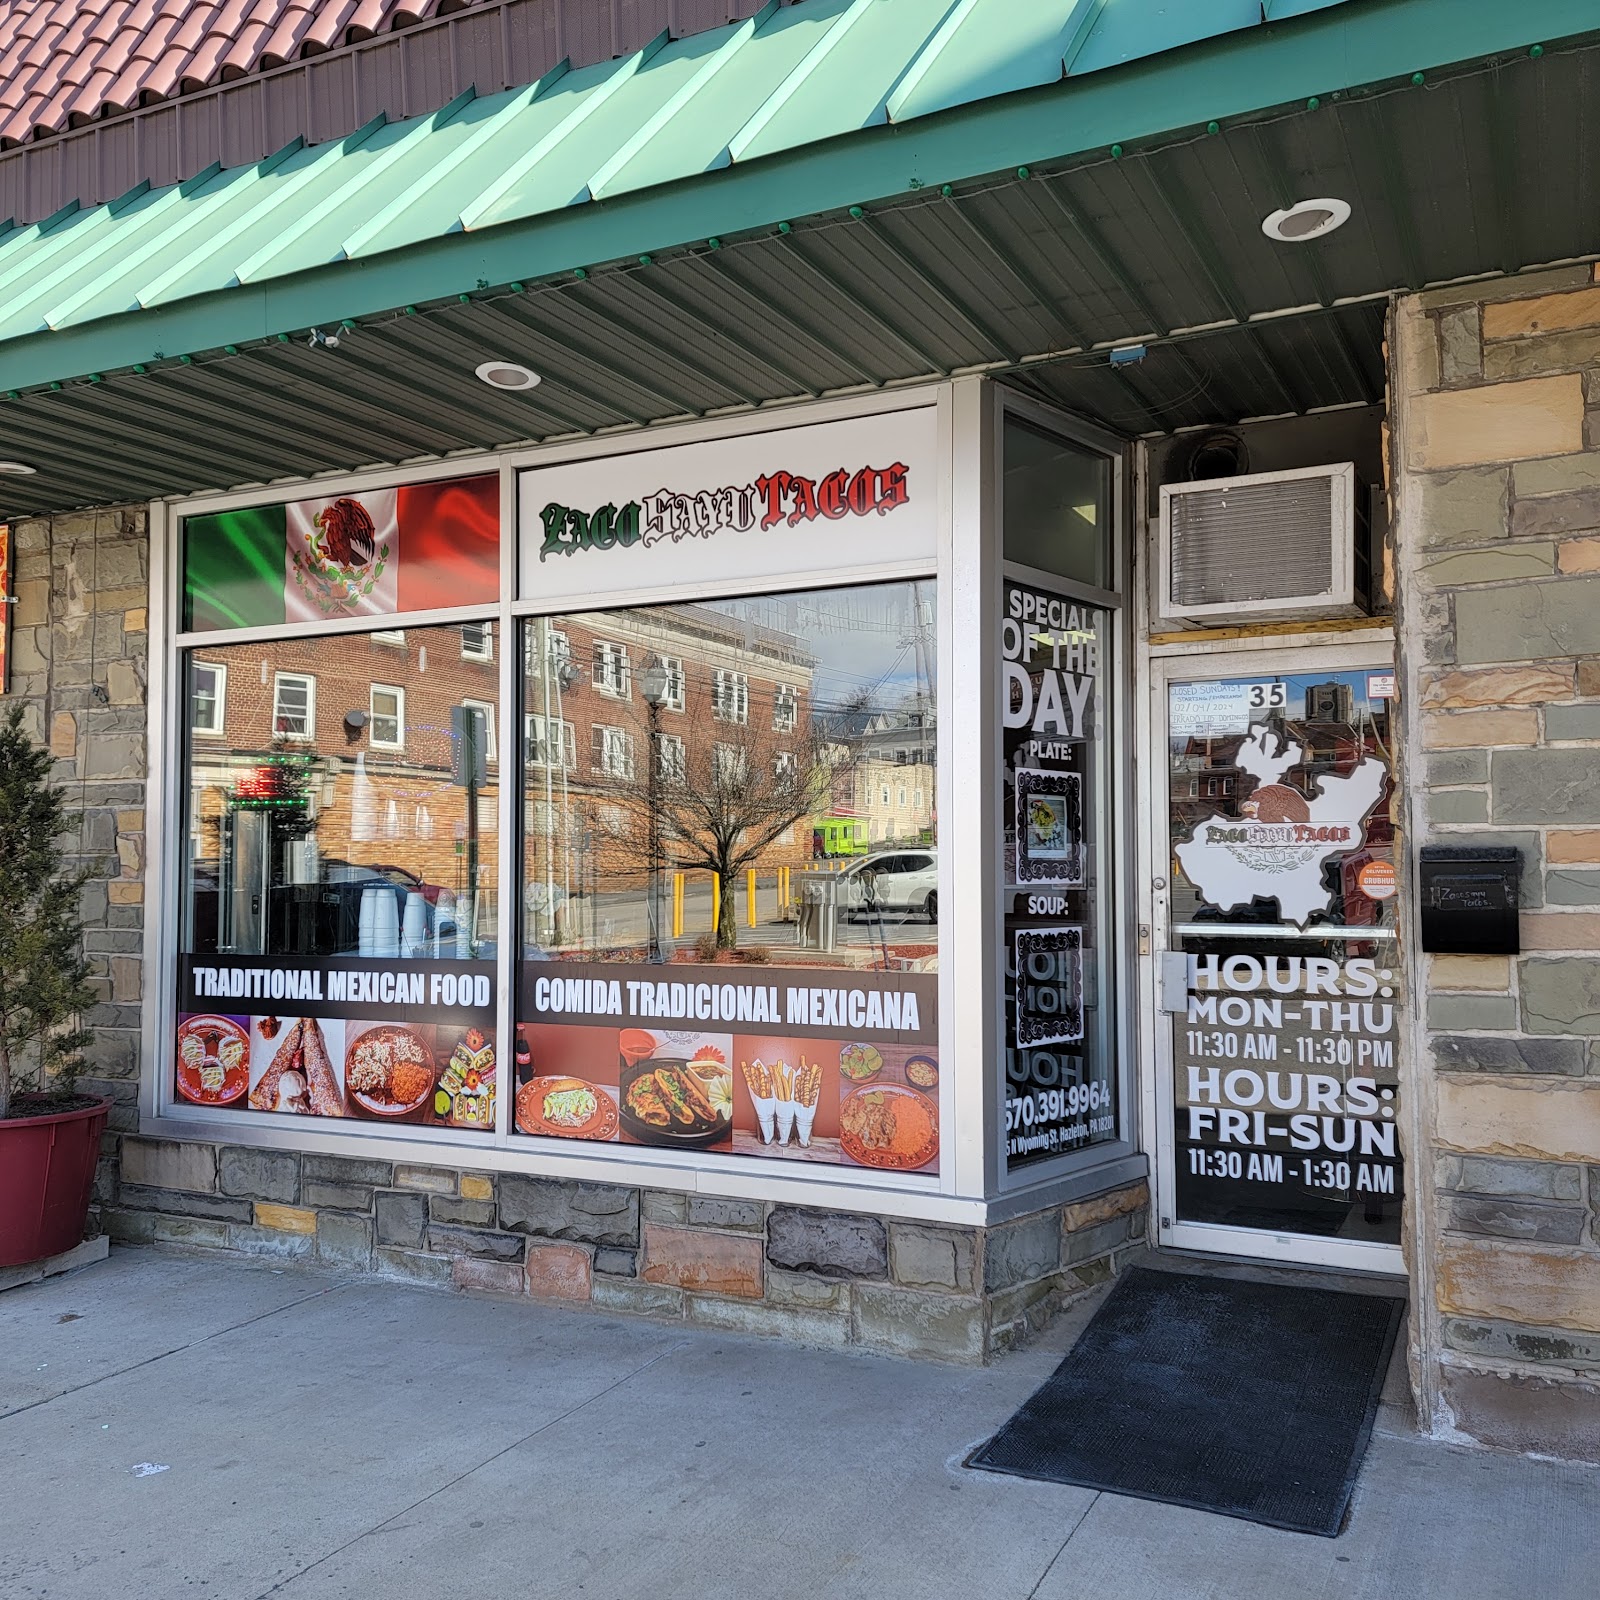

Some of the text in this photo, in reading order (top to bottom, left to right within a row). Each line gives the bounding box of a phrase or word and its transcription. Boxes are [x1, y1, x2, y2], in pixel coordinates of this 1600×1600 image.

[1003, 617, 1100, 676] OF THE
[1003, 660, 1092, 738] DAY
[1170, 687, 1198, 696] CLOSED
[1249, 684, 1284, 708] 35
[1029, 740, 1072, 761] PLATE:
[1363, 877, 1395, 885] GRUBHUB
[1028, 895, 1069, 916] SOUP:
[192, 966, 491, 1007] TRADITIONAL MEXICAN FOOD
[1187, 953, 1393, 998] HOURS:
[535, 976, 921, 1031] COMIDA TRADICIONAL MEXICANA
[1187, 995, 1394, 1034] MON-THU
[1186, 1030, 1238, 1058] 11:30
[1243, 1033, 1278, 1061] AM
[1296, 1036, 1351, 1066] 11:30
[1358, 1039, 1394, 1068] PM
[1005, 1079, 1111, 1132] 570.391.9964
[1187, 1065, 1394, 1118] HOURS:
[1011, 1138, 1017, 1155] N
[1017, 1131, 1050, 1156] Wyoming
[1049, 1128, 1059, 1145] St.
[1060, 1123, 1090, 1142] Hazleton,
[1089, 1117, 1099, 1135] PA
[1098, 1114, 1115, 1133] 18201
[1188, 1105, 1396, 1158] FRI-SUN
[1187, 1147, 1242, 1179] 11:30
[1247, 1152, 1284, 1184] AM
[1302, 1157, 1351, 1191] 1:30
[1357, 1162, 1395, 1195] AM
